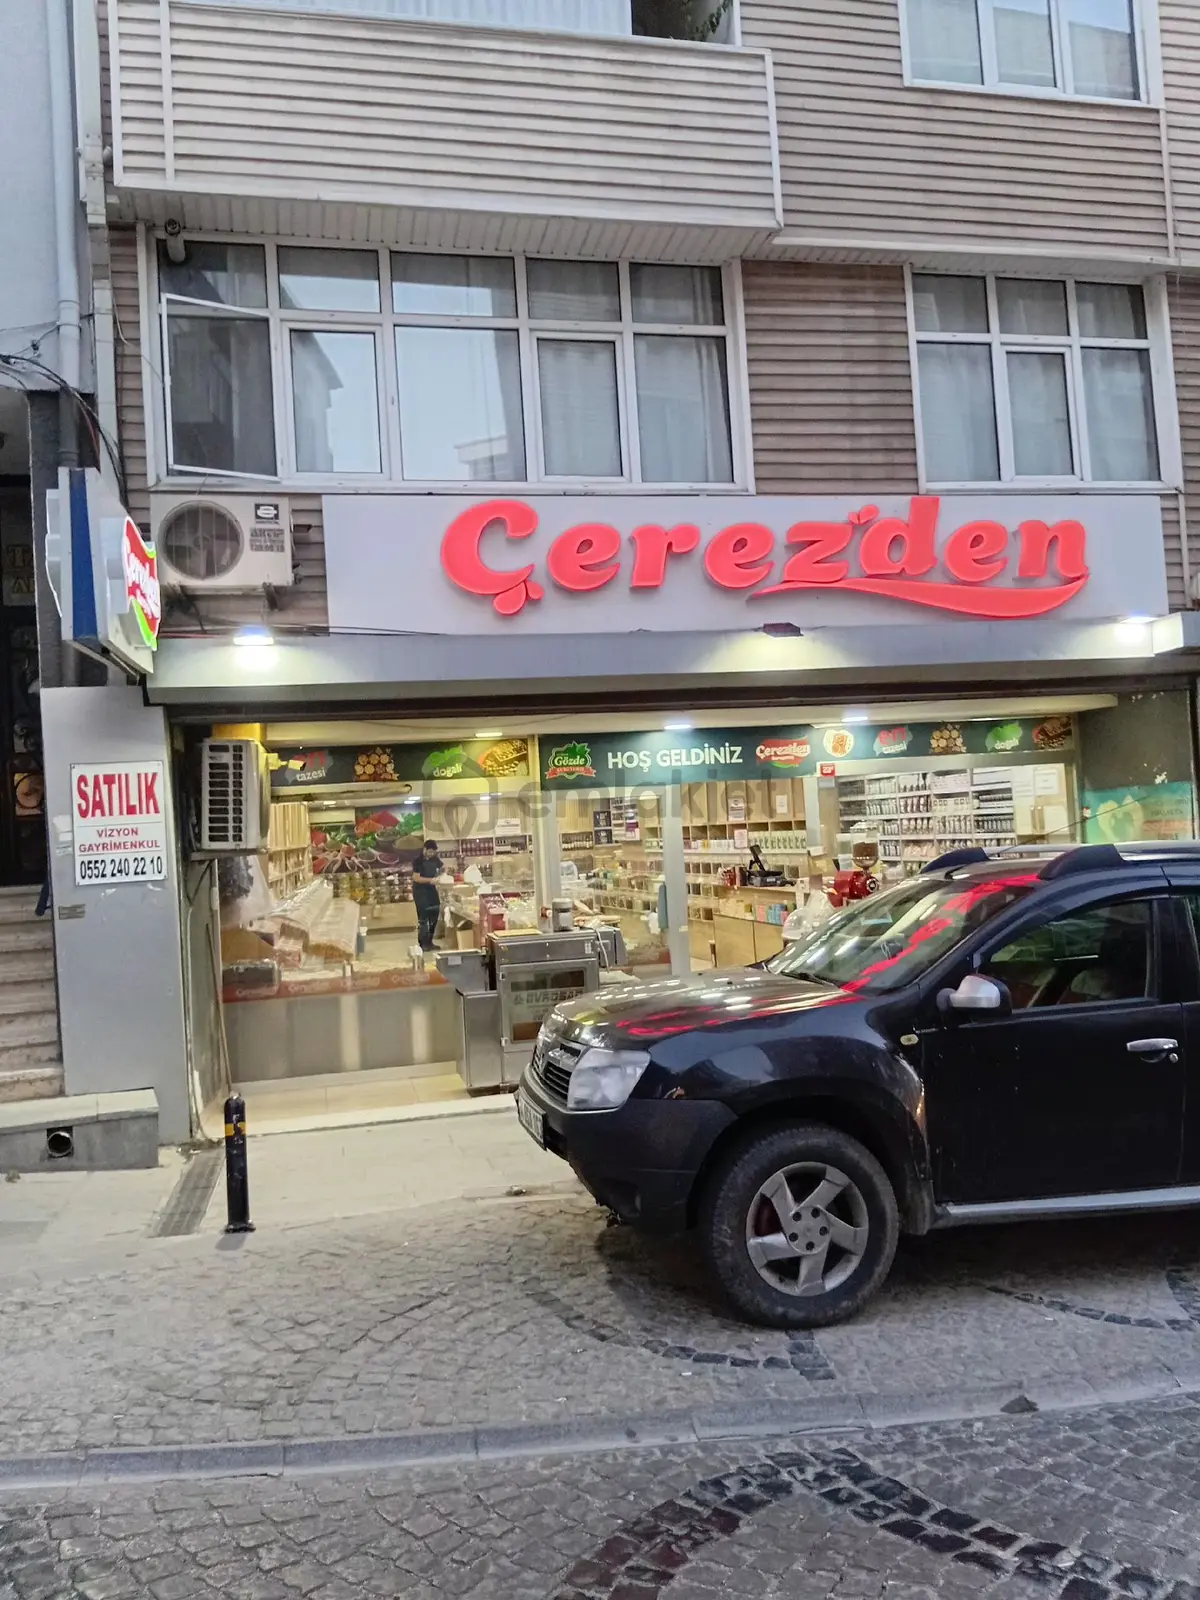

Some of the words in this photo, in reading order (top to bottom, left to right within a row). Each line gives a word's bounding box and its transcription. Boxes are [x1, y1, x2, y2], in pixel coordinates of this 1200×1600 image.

[554, 755, 585, 767] Gözde
[607, 751, 651, 772] HOŞ
[656, 742, 743, 767] GELDİNİZ
[295, 767, 326, 781] tazesi
[77, 772, 160, 818] SATILIK
[97, 827, 138, 838] VİZYON
[79, 839, 160, 853] GAYRİMENKUL
[80, 859, 107, 880] 0552
[110, 857, 130, 877] 240
[133, 856, 147, 875] 22
[151, 856, 162, 874] 10
